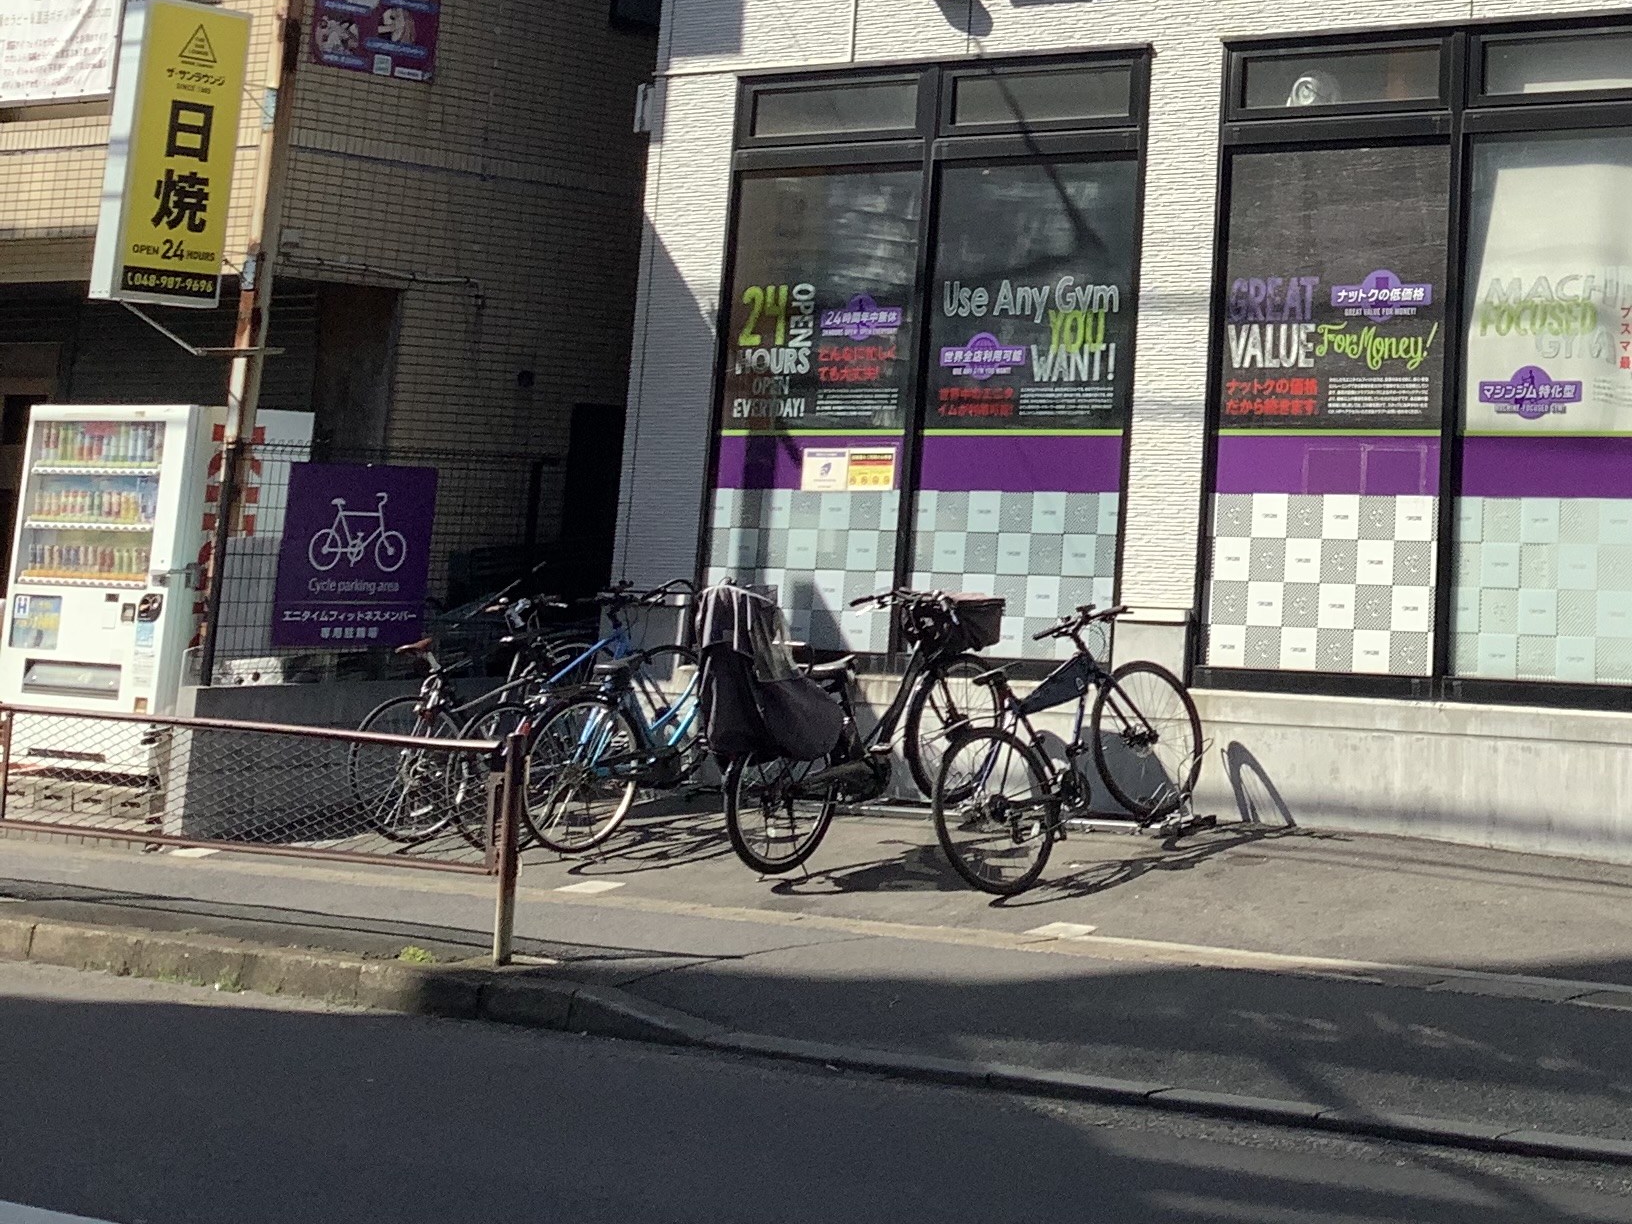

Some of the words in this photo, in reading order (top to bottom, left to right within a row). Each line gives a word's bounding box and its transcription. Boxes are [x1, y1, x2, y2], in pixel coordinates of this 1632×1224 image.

[150, 99, 215, 233] 日焼
[132, 243, 160, 256] OPEN
[161, 238, 185, 262] 24
[185, 249, 216, 262] HOURS
[943, 279, 990, 318] Use
[992, 279, 1051, 324] Any
[1228, 276, 1320, 322] GREAT
[1336, 287, 1425, 303] ナットクの低価格
[738, 283, 789, 347] 24
[788, 282, 816, 348] OPEN
[1048, 308, 1106, 353] YOU
[1479, 299, 1598, 337] FOCUSED
[734, 347, 812, 376] HOURS
[943, 349, 1023, 363] 世界全店利用可能
[1031, 342, 1117, 383] WANT!
[1227, 323, 1316, 369] VALUE
[751, 376, 791, 396] OPEN
[1482, 383, 1577, 399] マシンジム特化型
[732, 397, 806, 419] EVERYDAY!
[308, 577, 337, 595] Cycle
[338, 579, 377, 596] parking
[377, 581, 400, 592] area
[282, 610, 417, 623] エニタイムフィットネスメンバー
